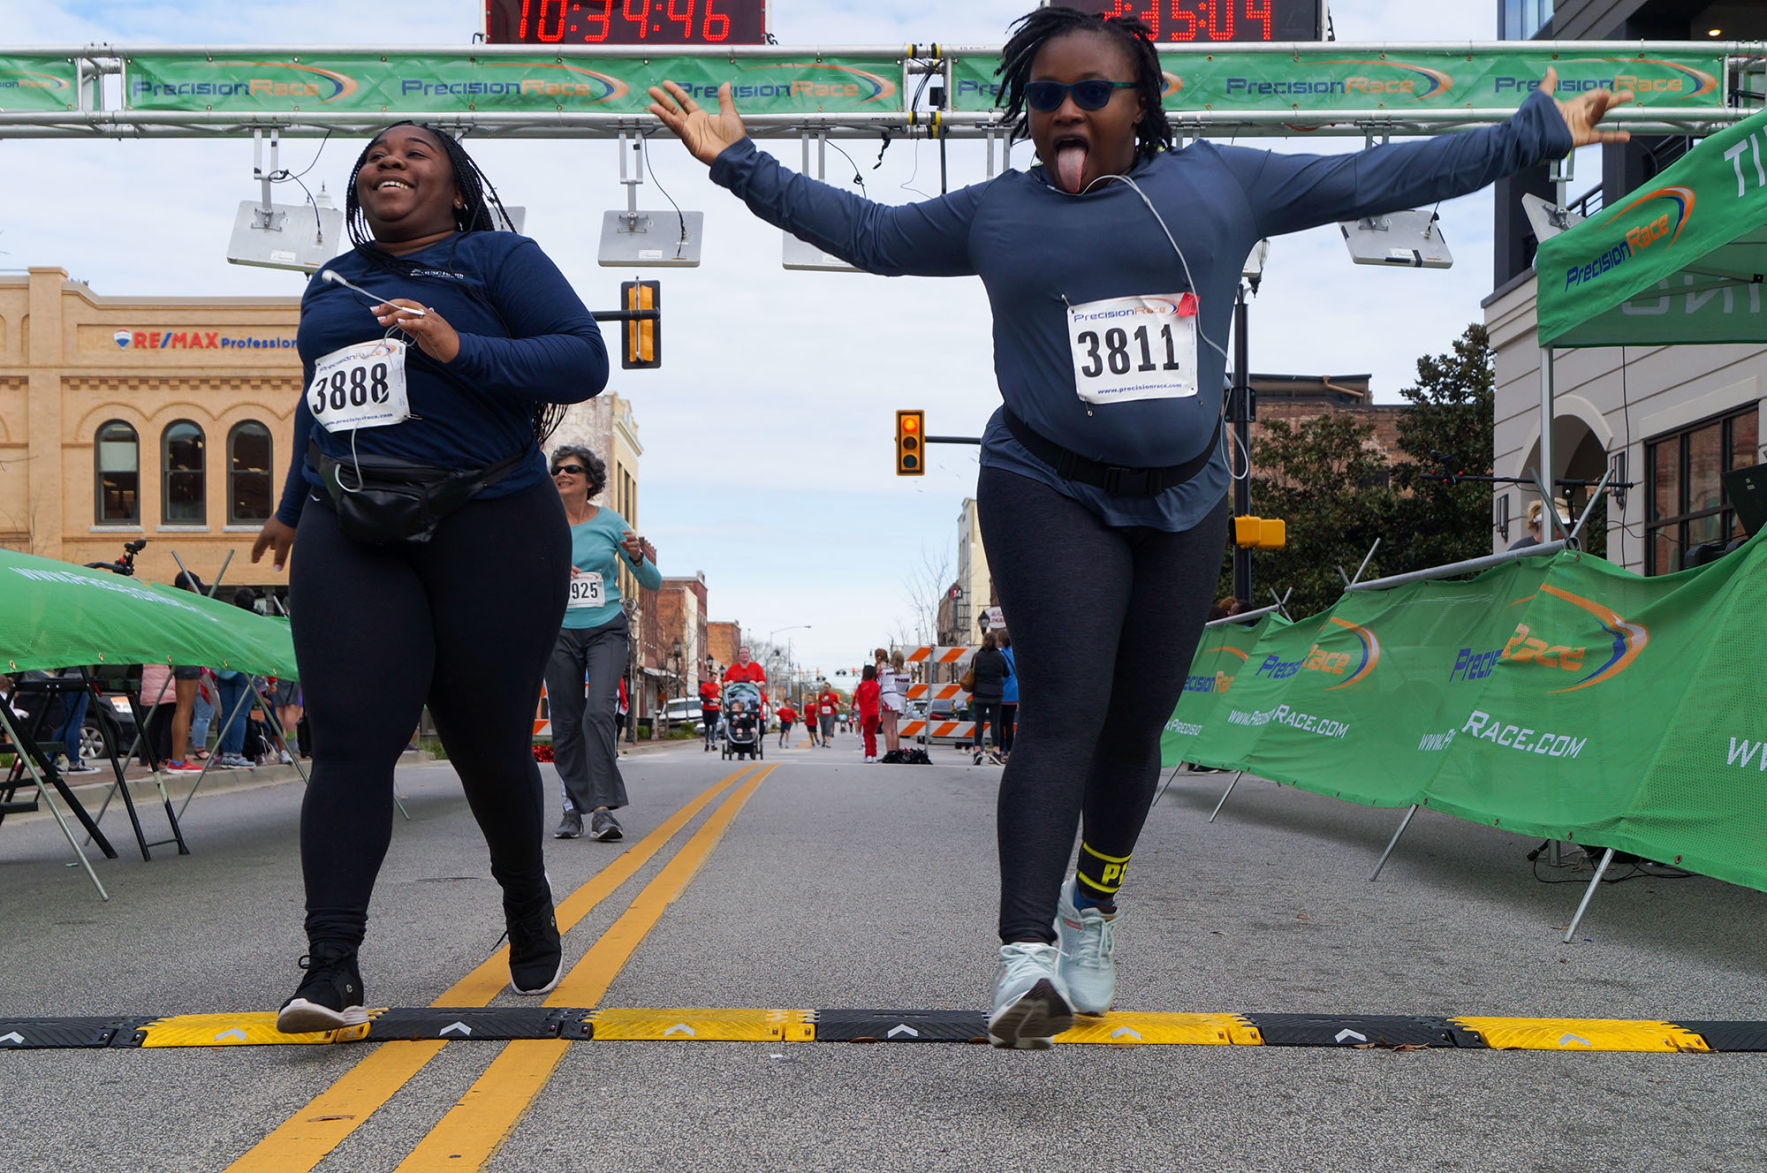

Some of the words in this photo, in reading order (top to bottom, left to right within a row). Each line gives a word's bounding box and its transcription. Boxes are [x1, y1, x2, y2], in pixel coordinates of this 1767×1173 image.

[132, 79, 319, 97] PrecisionRace
[401, 79, 591, 97] PrecisionRace
[676, 80, 859, 98] PreisionRace
[1226, 77, 1415, 95] PrecisionRace
[1494, 75, 1682, 94] PreisionRace
[1723, 125, 1767, 198] TI
[1564, 213, 1670, 293] PrecisionRace
[1073, 305, 1168, 323] PrecisionRace
[133, 331, 219, 349] RE/MAX
[1077, 323, 1180, 378] 3811
[312, 362, 390, 415] 3888
[1097, 383, 1182, 395] www.precisionrace.com
[571, 582, 598, 600] 925
[1461, 710, 1588, 759] RACE.COM
